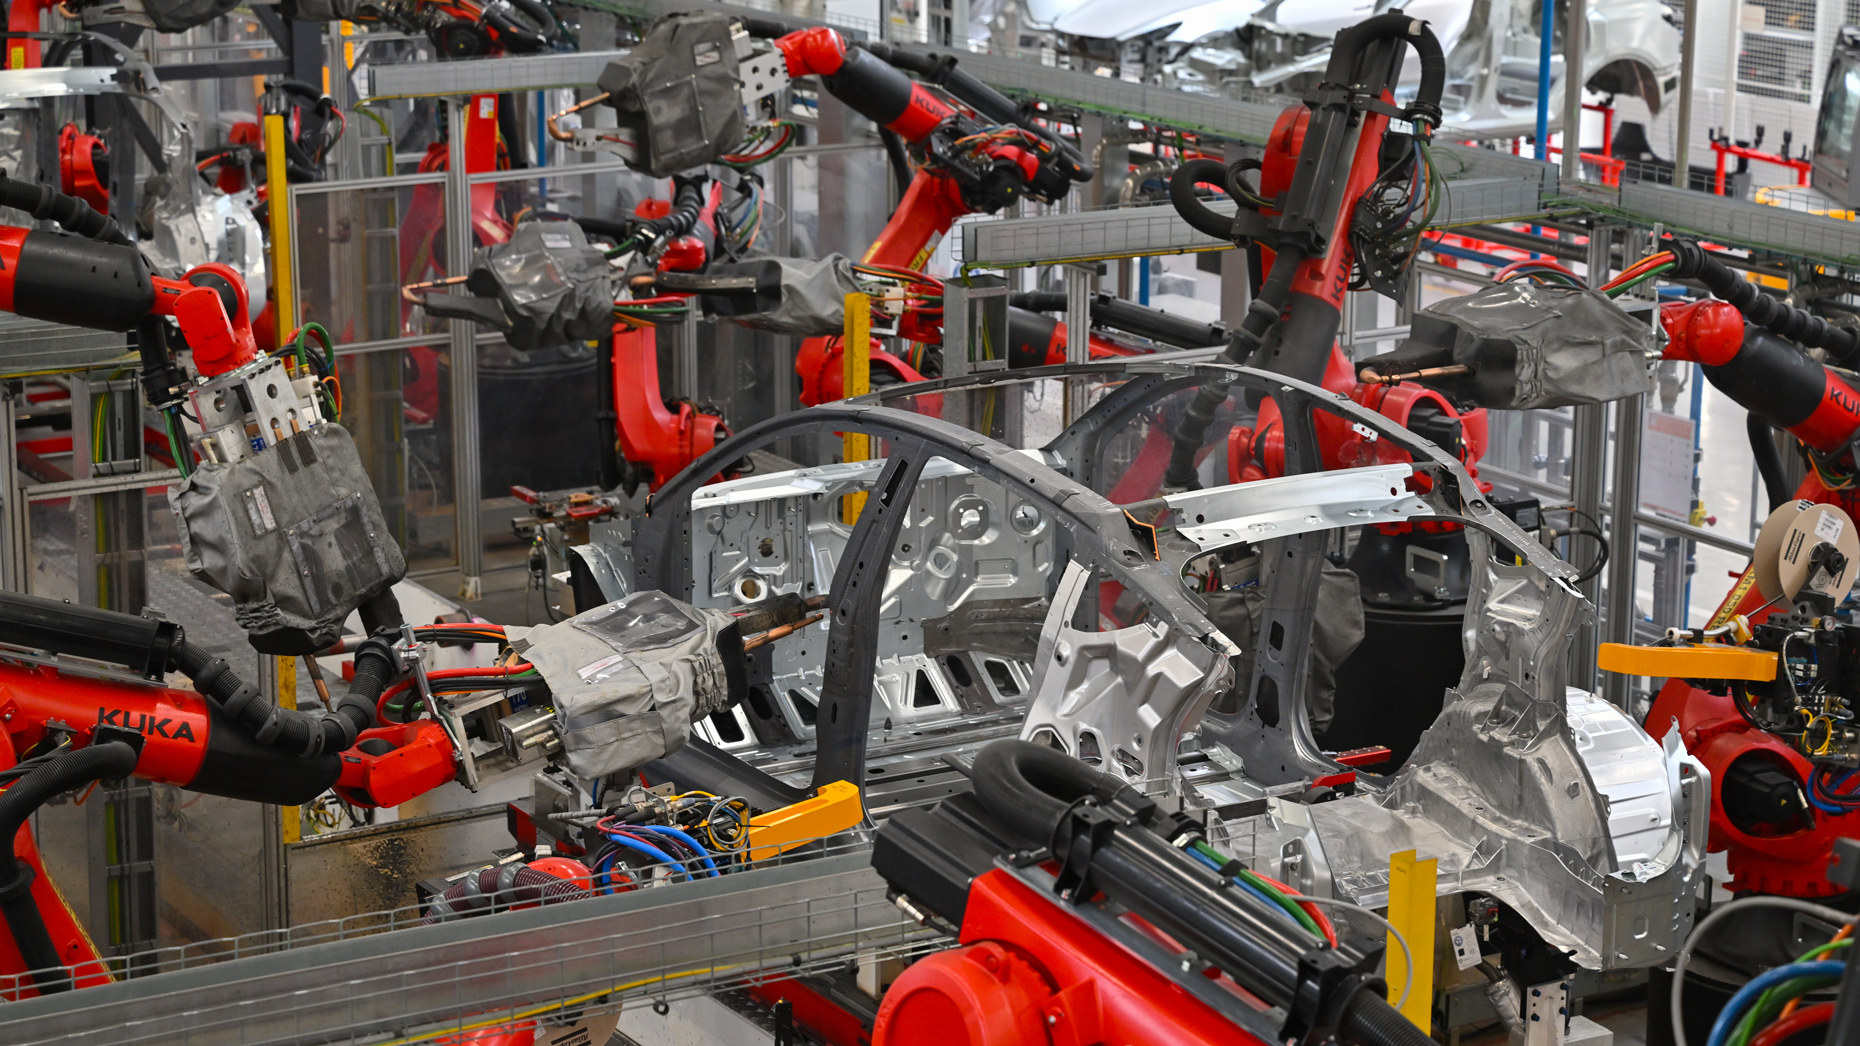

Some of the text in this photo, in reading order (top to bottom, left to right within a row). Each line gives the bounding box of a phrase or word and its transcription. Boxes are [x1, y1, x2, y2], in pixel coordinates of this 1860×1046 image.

[915, 95, 947, 120] KUK
[1331, 246, 1353, 302] KUK
[1722, 594, 1741, 614] 050
[97, 706, 196, 743] KUKA
[570, 1032, 590, 1045] Atlas
